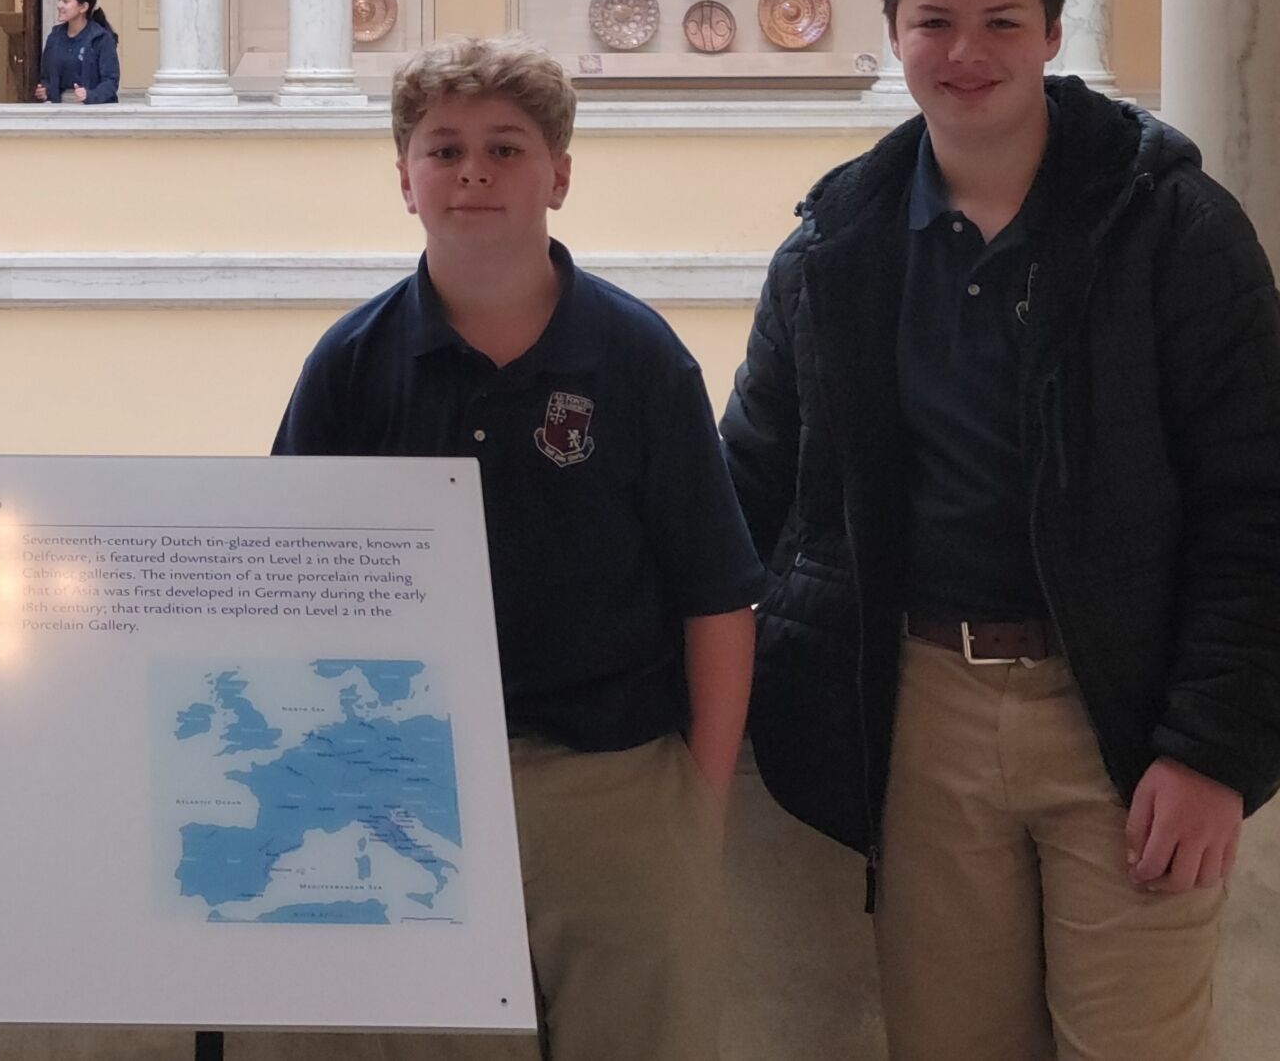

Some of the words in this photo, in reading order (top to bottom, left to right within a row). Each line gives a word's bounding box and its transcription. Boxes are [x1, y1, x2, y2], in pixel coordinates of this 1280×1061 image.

[21, 533, 157, 548] Seventeenth-century
[161, 535, 201, 546] Dutch
[206, 535, 270, 550] tin-glazed
[274, 536, 362, 549] earthenware,
[366, 537, 411, 549] known
[415, 541, 430, 549] as
[22, 550, 91, 563] Delftware,
[96, 552, 105, 562] is
[110, 551, 165, 562] featured
[169, 552, 243, 563] downstairs
[269, 553, 301, 564] Level
[305, 556, 312, 564] 2
[316, 554, 328, 564] in
[333, 553, 355, 564] the
[359, 554, 400, 565] Dutch
[22, 617, 83, 631] Porcelain
[88, 619, 139, 633] Gallery.
